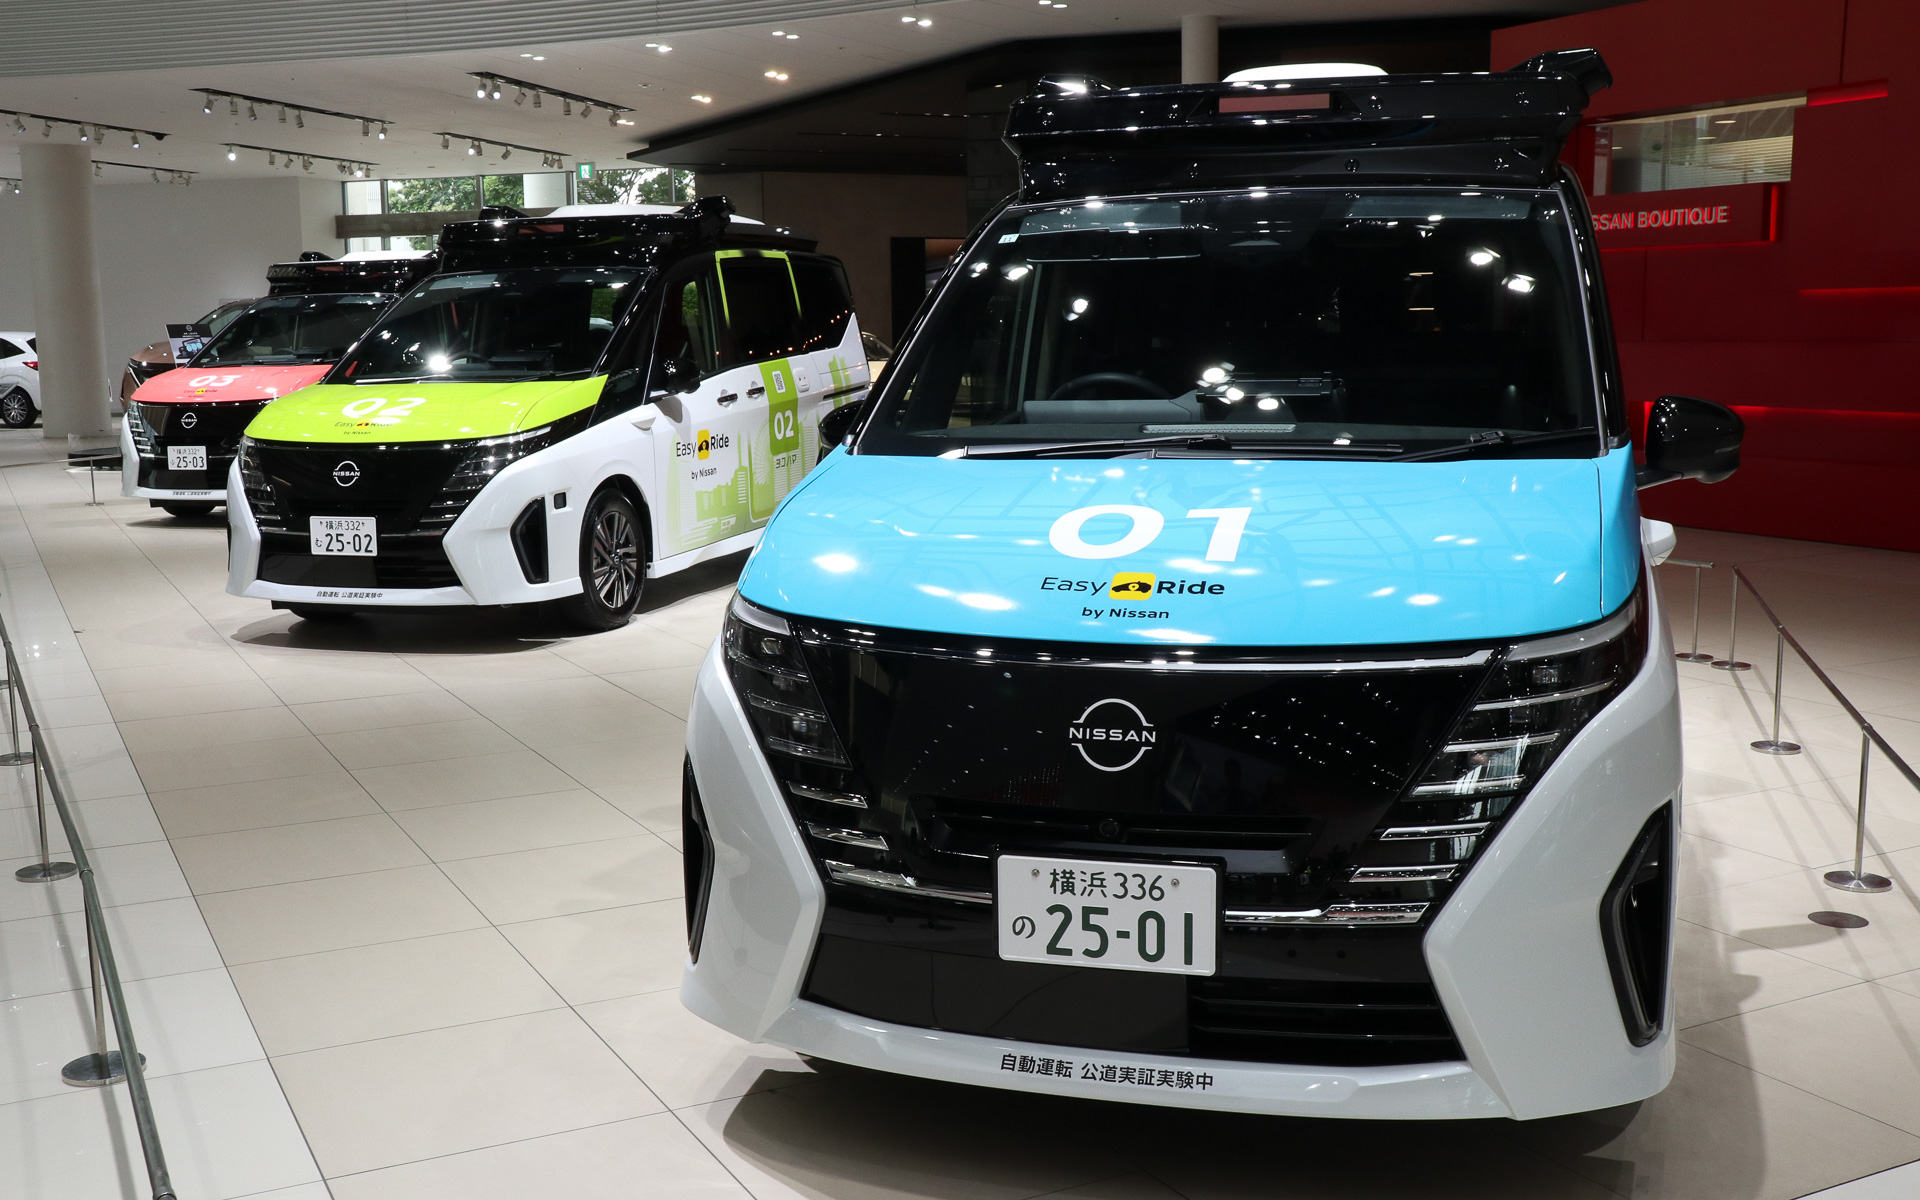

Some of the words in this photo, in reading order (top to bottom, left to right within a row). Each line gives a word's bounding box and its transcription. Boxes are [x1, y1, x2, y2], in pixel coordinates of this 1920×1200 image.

[1591, 211, 1632, 231] SSAN
[1637, 205, 1729, 228] BOUTIQUE
[188, 374, 243, 387] 03
[341, 397, 427, 417] 02
[334, 421, 356, 429] Easy
[773, 409, 795, 441] 02
[676, 441, 697, 458] Easy
[710, 433, 730, 451] Ride
[176, 456, 205, 468] 25-03
[691, 470, 698, 480] by
[699, 467, 717, 478] Nissan
[325, 520, 361, 531] 横浜332
[1048, 504, 1253, 562] 01
[324, 533, 374, 553] 25-02
[1040, 576, 1108, 597] Easy
[1156, 580, 1226, 595] Ride
[1081, 606, 1104, 620] by
[1109, 607, 1170, 619] Nissan
[1069, 726, 1156, 743] NISSAN
[1049, 867, 1165, 902] 横浜336
[1011, 915, 1036, 939] の
[1045, 903, 1194, 966] 25-01
[1000, 1053, 1074, 1079] 自動運転
[1081, 1062, 1214, 1091] 公道実証実験中
